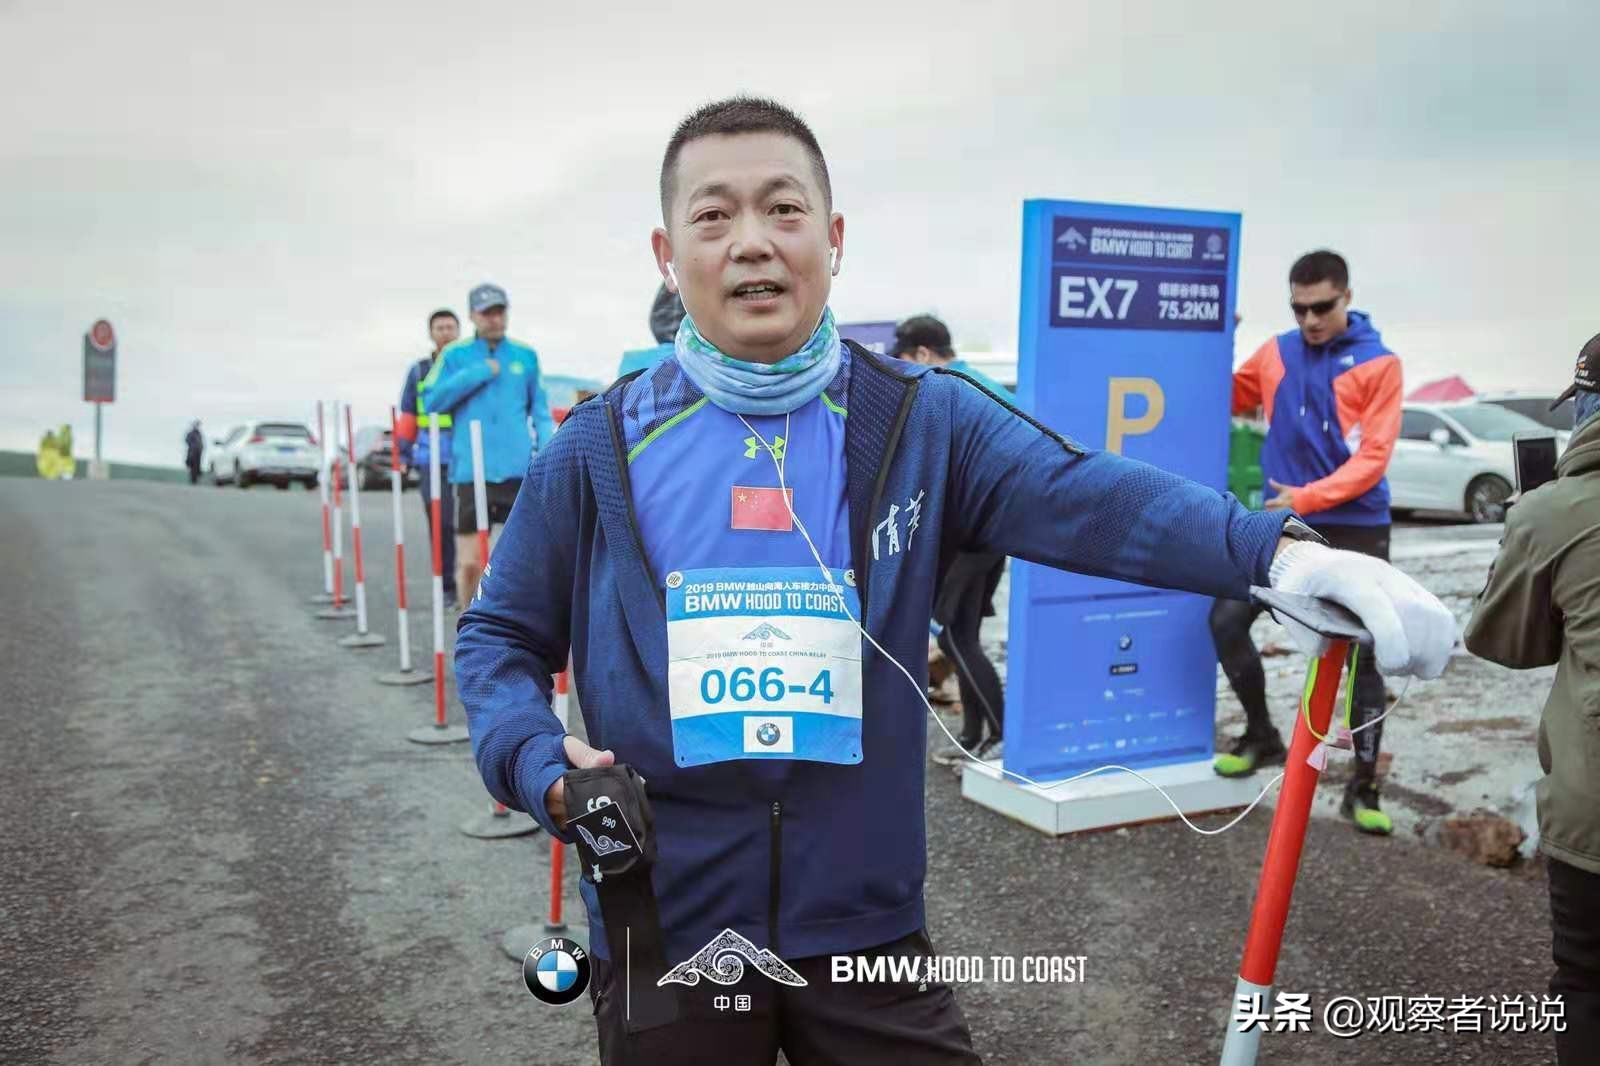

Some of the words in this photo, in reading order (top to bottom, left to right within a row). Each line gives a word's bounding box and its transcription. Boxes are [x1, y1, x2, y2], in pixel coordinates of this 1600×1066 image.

[1090, 237, 1129, 256] BMW
[1058, 275, 1139, 320] EX7
[1158, 300, 1219, 320] 75.2KM
[1105, 377, 1165, 457] P
[685, 582, 714, 594] 2019
[716, 581, 745, 592] BMW
[685, 592, 743, 613] BMW
[745, 593, 782, 610] HOOD
[785, 593, 802, 610] TO
[805, 594, 845, 613] COAST
[700, 666, 835, 705] 066-4
